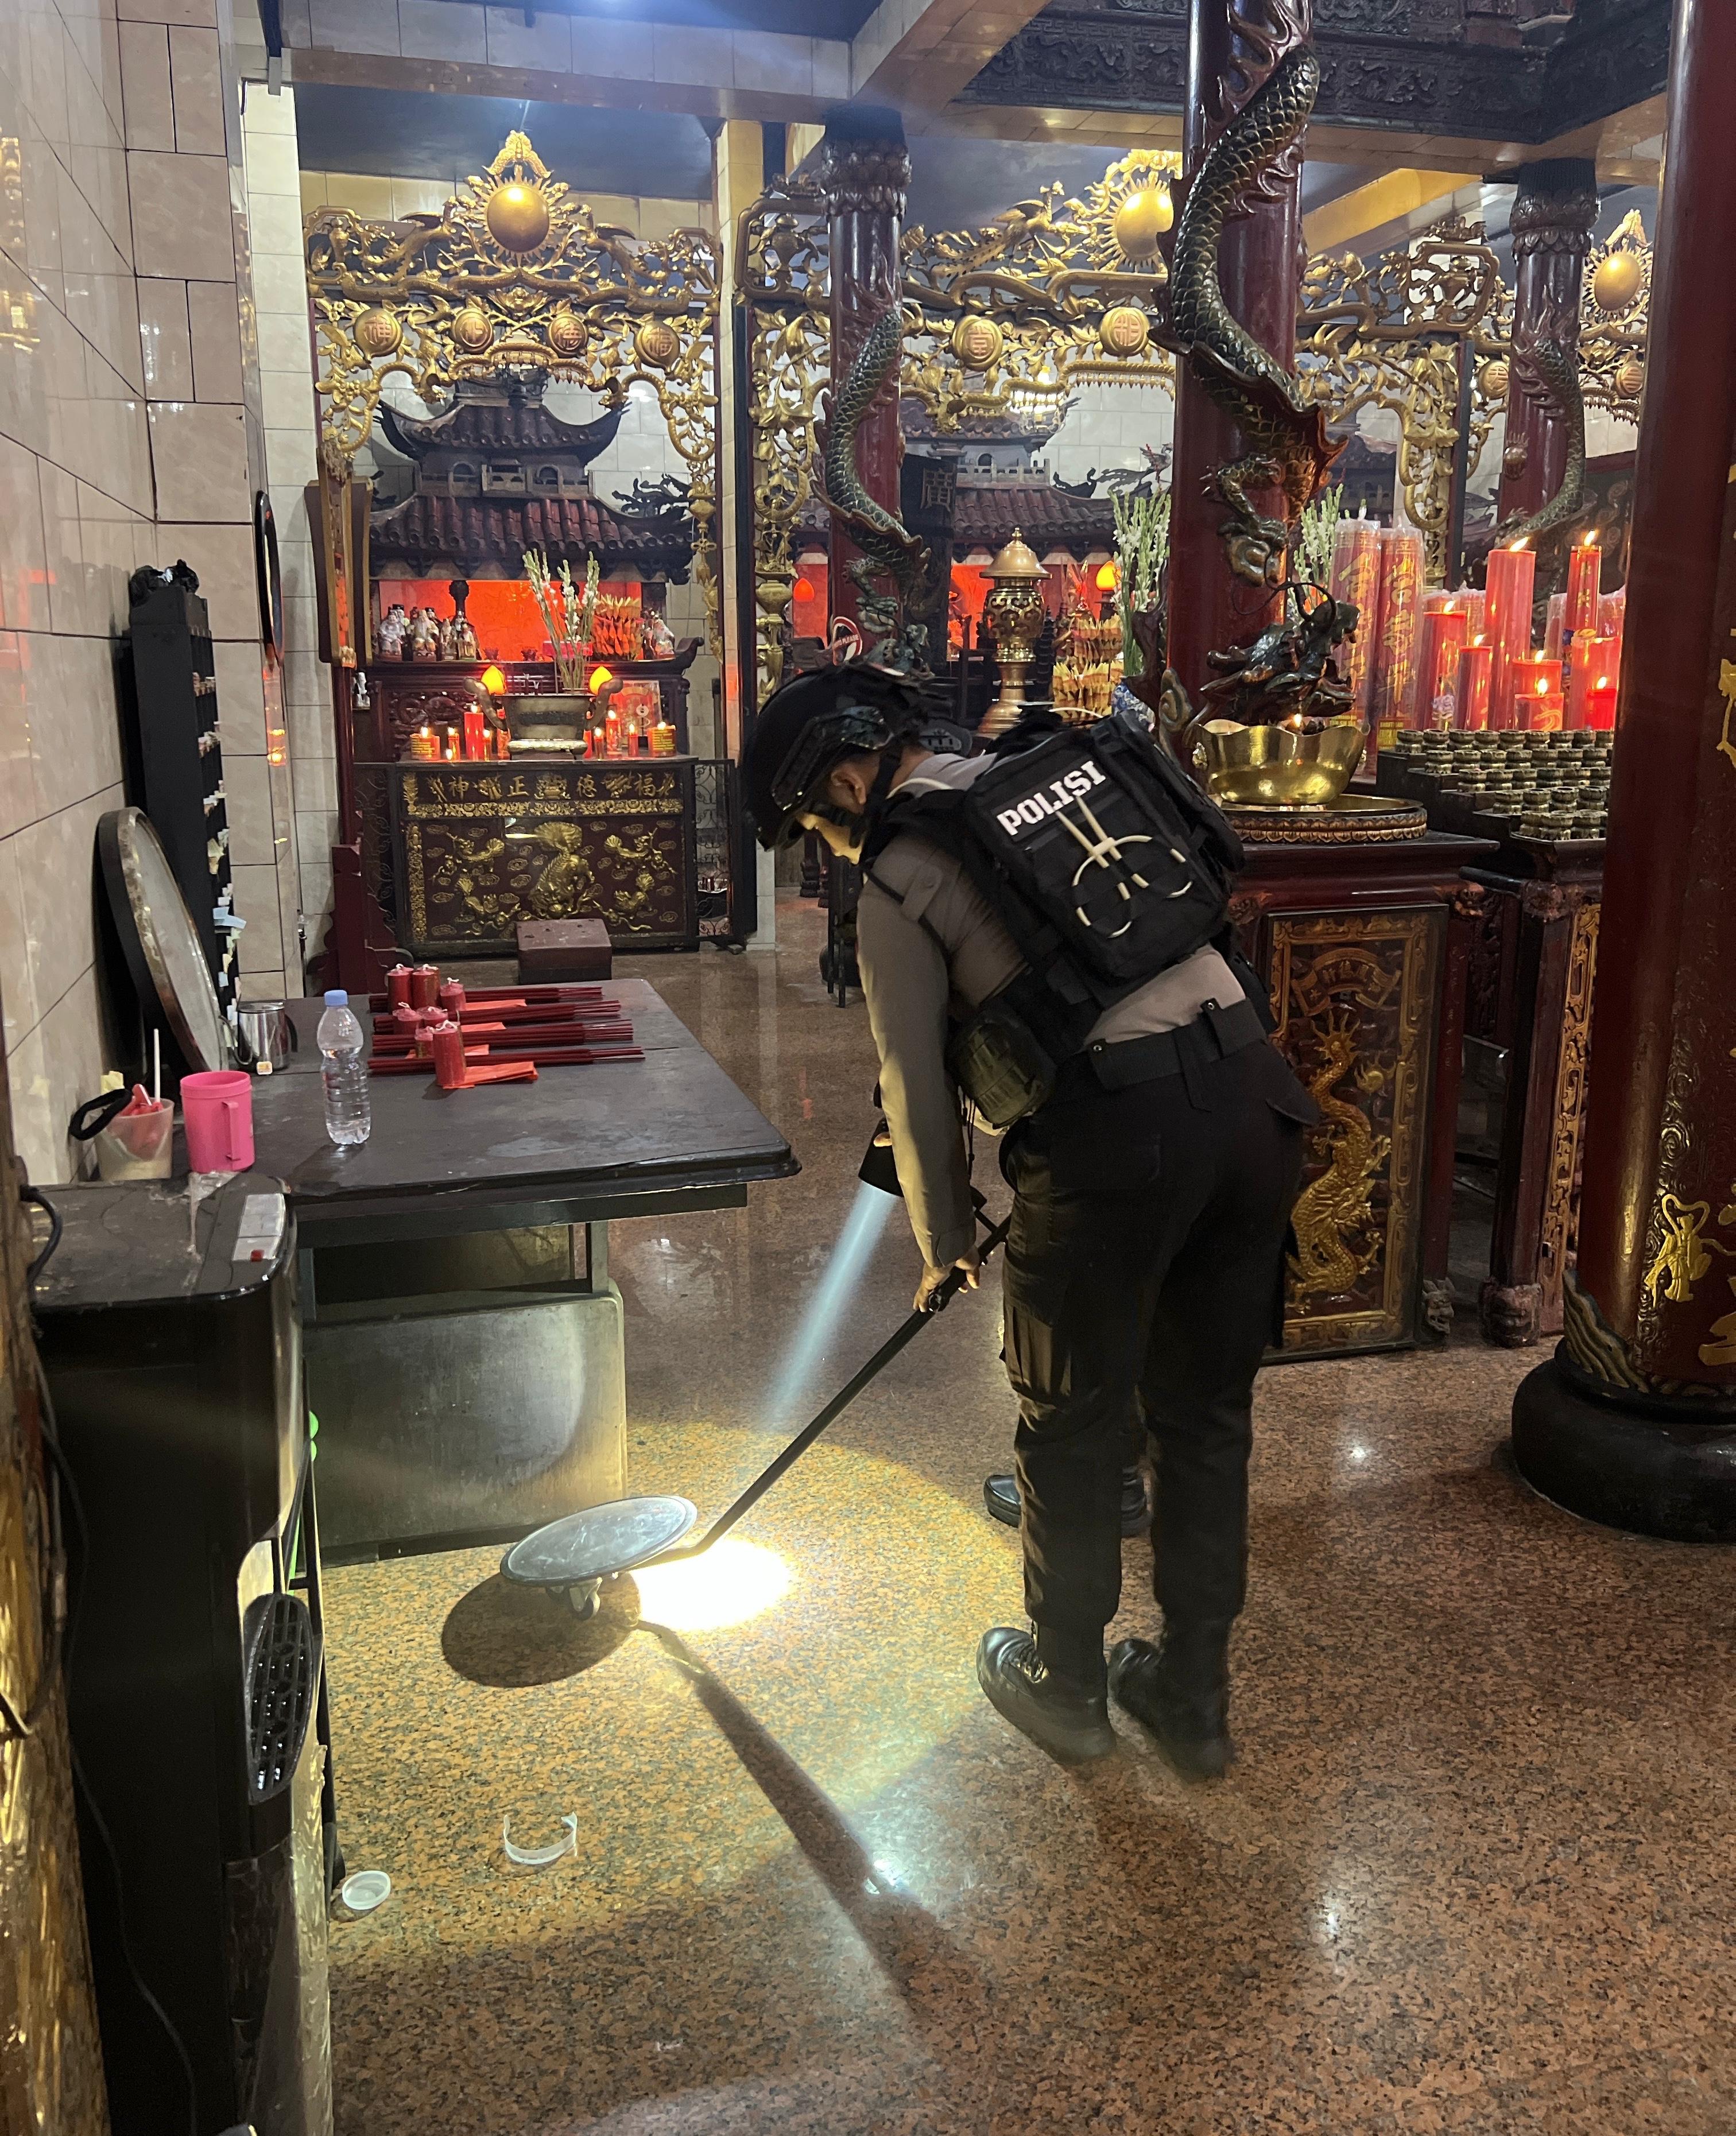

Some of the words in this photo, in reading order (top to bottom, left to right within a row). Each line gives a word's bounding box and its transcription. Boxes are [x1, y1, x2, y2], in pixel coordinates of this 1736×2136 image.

[448, 775, 470, 800] 神
[506, 775, 529, 797] 正
[634, 773, 657, 797] 福
[997, 760, 1107, 836] POLISI
